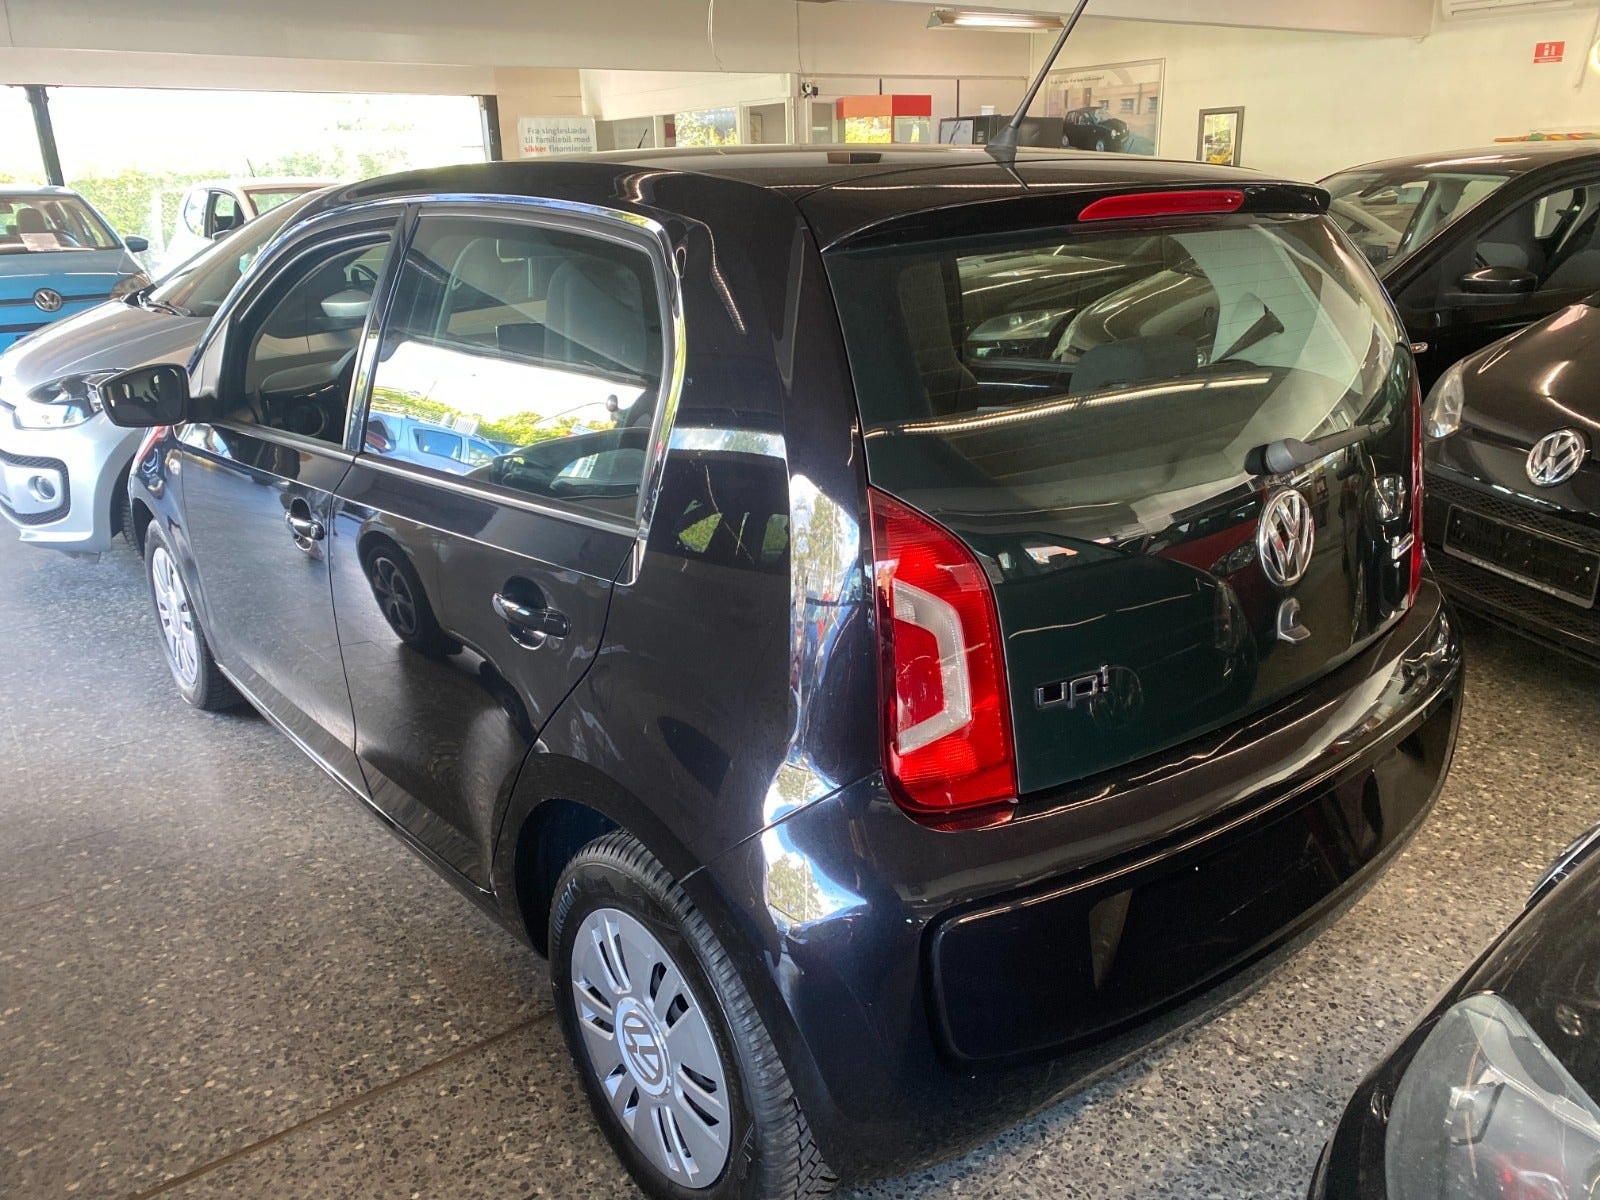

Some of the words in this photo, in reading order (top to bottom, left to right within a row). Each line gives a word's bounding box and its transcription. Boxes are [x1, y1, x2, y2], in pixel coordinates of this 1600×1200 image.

[527, 127, 540, 135] Fra
[524, 136, 534, 144] til
[536, 135, 572, 144] familiebil
[574, 135, 591, 143] med
[524, 145, 547, 153] sikker
